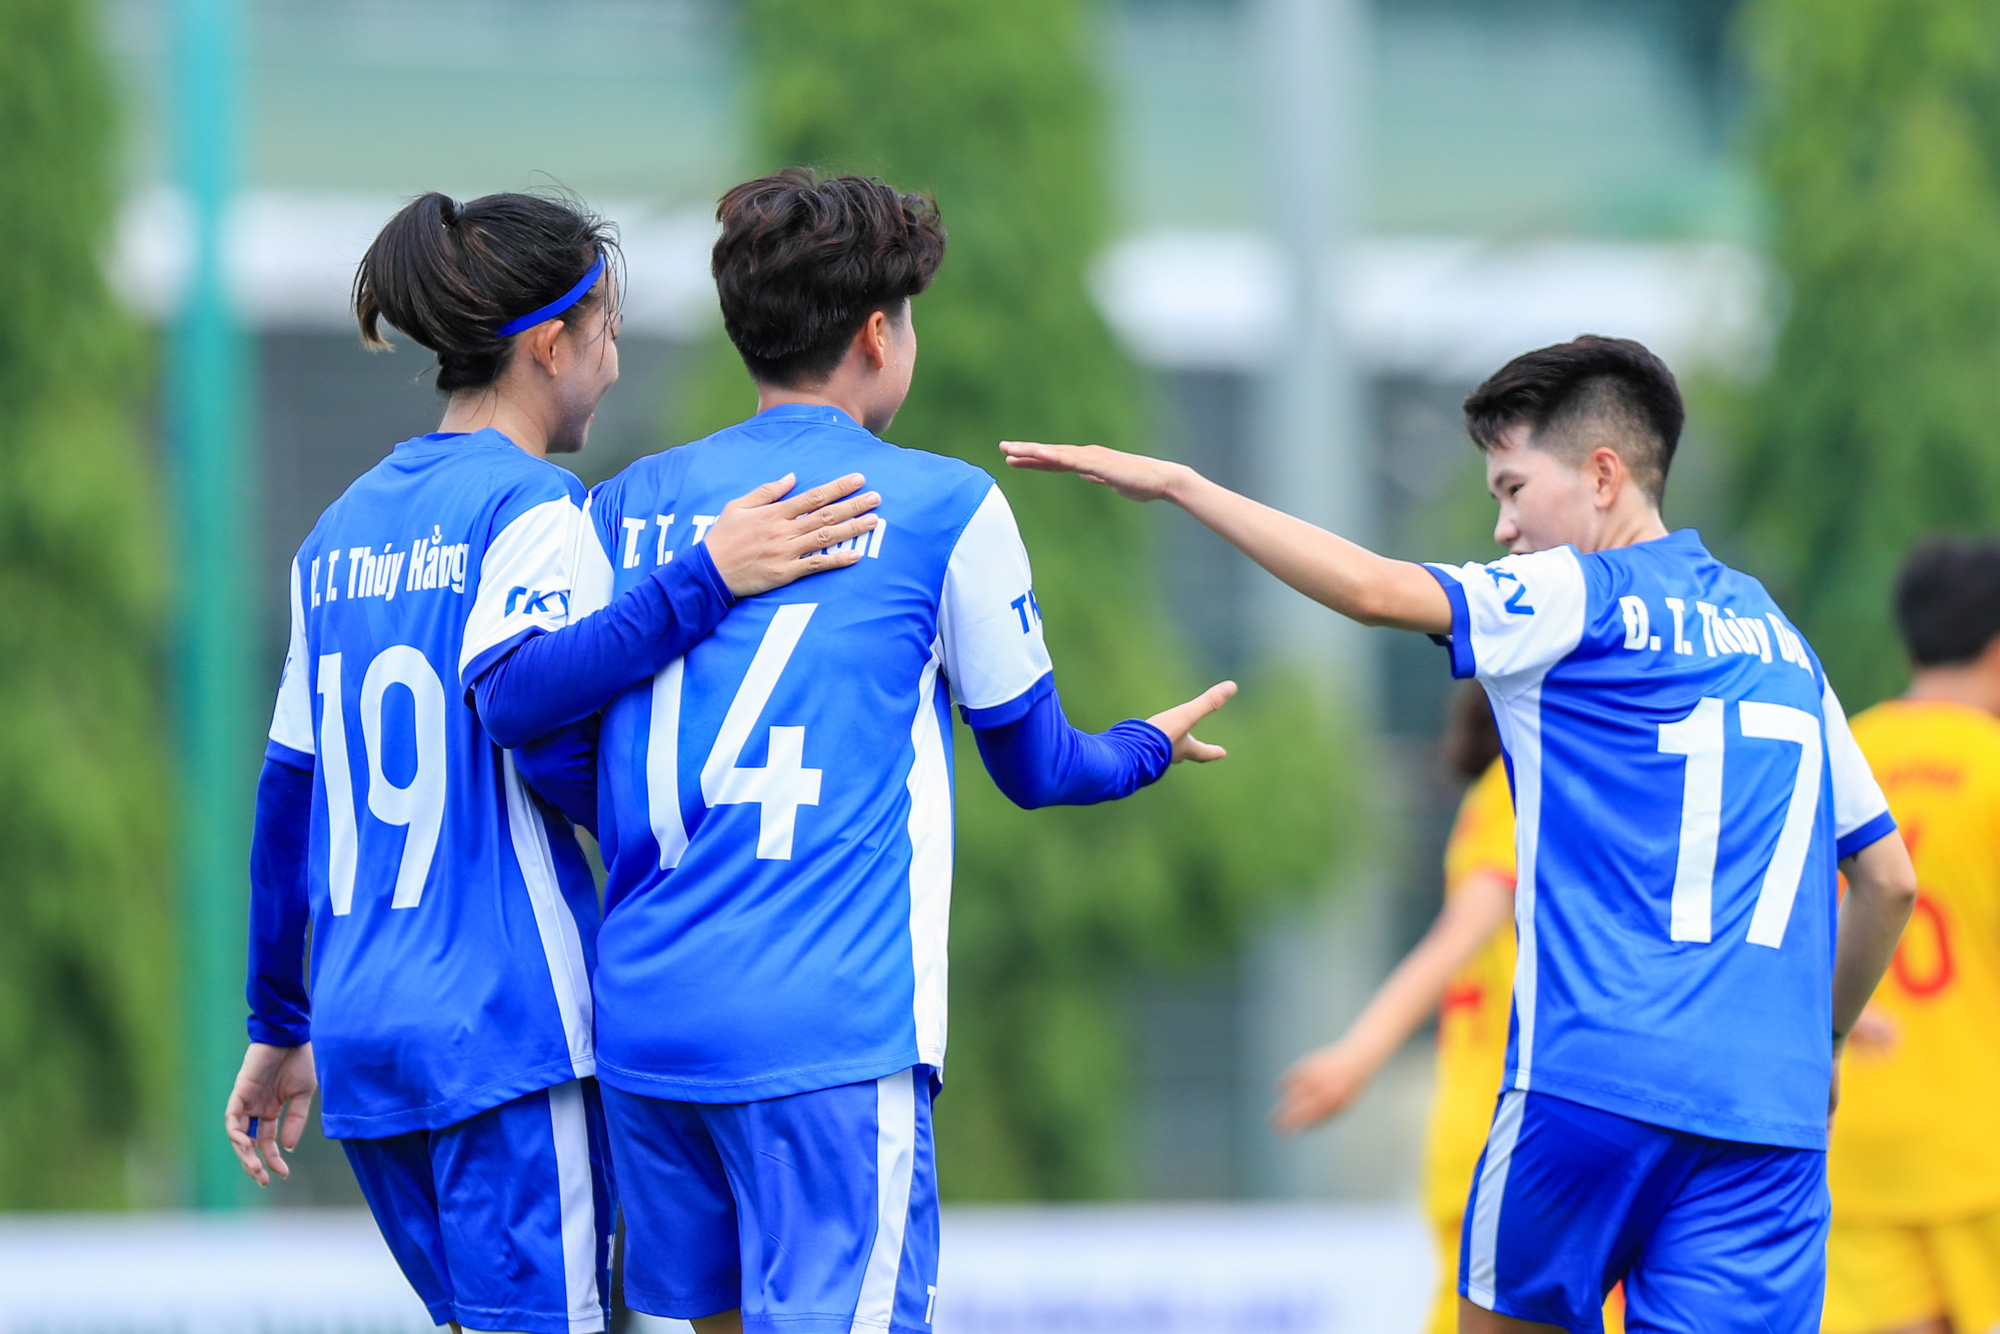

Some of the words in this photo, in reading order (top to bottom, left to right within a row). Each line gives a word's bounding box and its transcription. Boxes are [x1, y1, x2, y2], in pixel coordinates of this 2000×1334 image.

[326, 549, 341, 602] T.
[347, 542, 406, 601] Thúy
[406, 524, 470, 594] Hằng
[622, 516, 646, 569] T.
[1010, 589, 1042, 635] TK
[1618, 595, 1662, 652] Đ.
[1664, 597, 1693, 656] T.
[646, 603, 822, 870] 14
[316, 644, 447, 916] 19
[1657, 696, 1823, 949] 17
